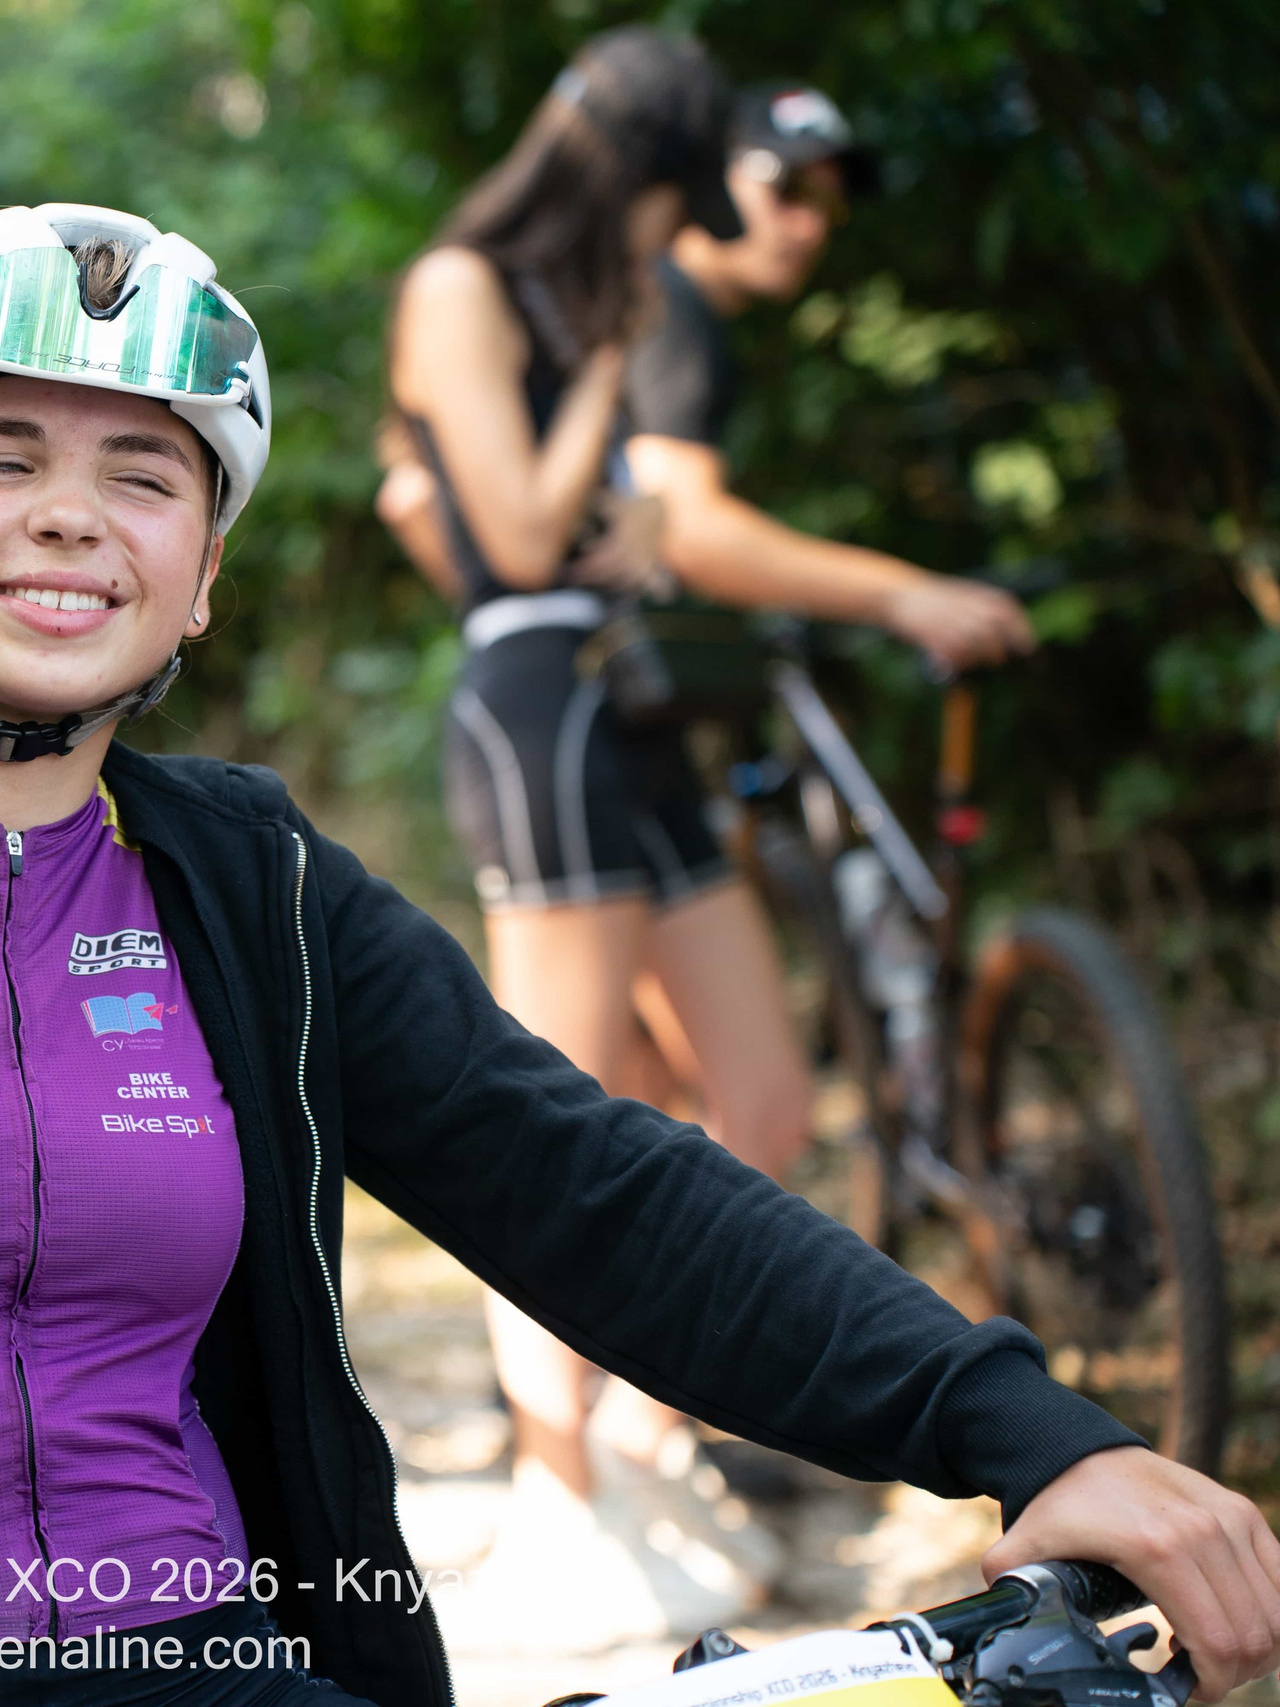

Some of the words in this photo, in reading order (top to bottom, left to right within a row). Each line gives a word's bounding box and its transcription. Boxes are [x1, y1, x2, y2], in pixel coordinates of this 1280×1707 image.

[53, 353, 136, 374] FORCE
[75, 933, 160, 957] DIEM
[71, 958, 159, 973] SPORT
[129, 1073, 174, 1085] BIKE
[117, 1087, 190, 1099] CENTER
[101, 1114, 165, 1133] Bike
[798, 1669, 838, 1691] 2026
